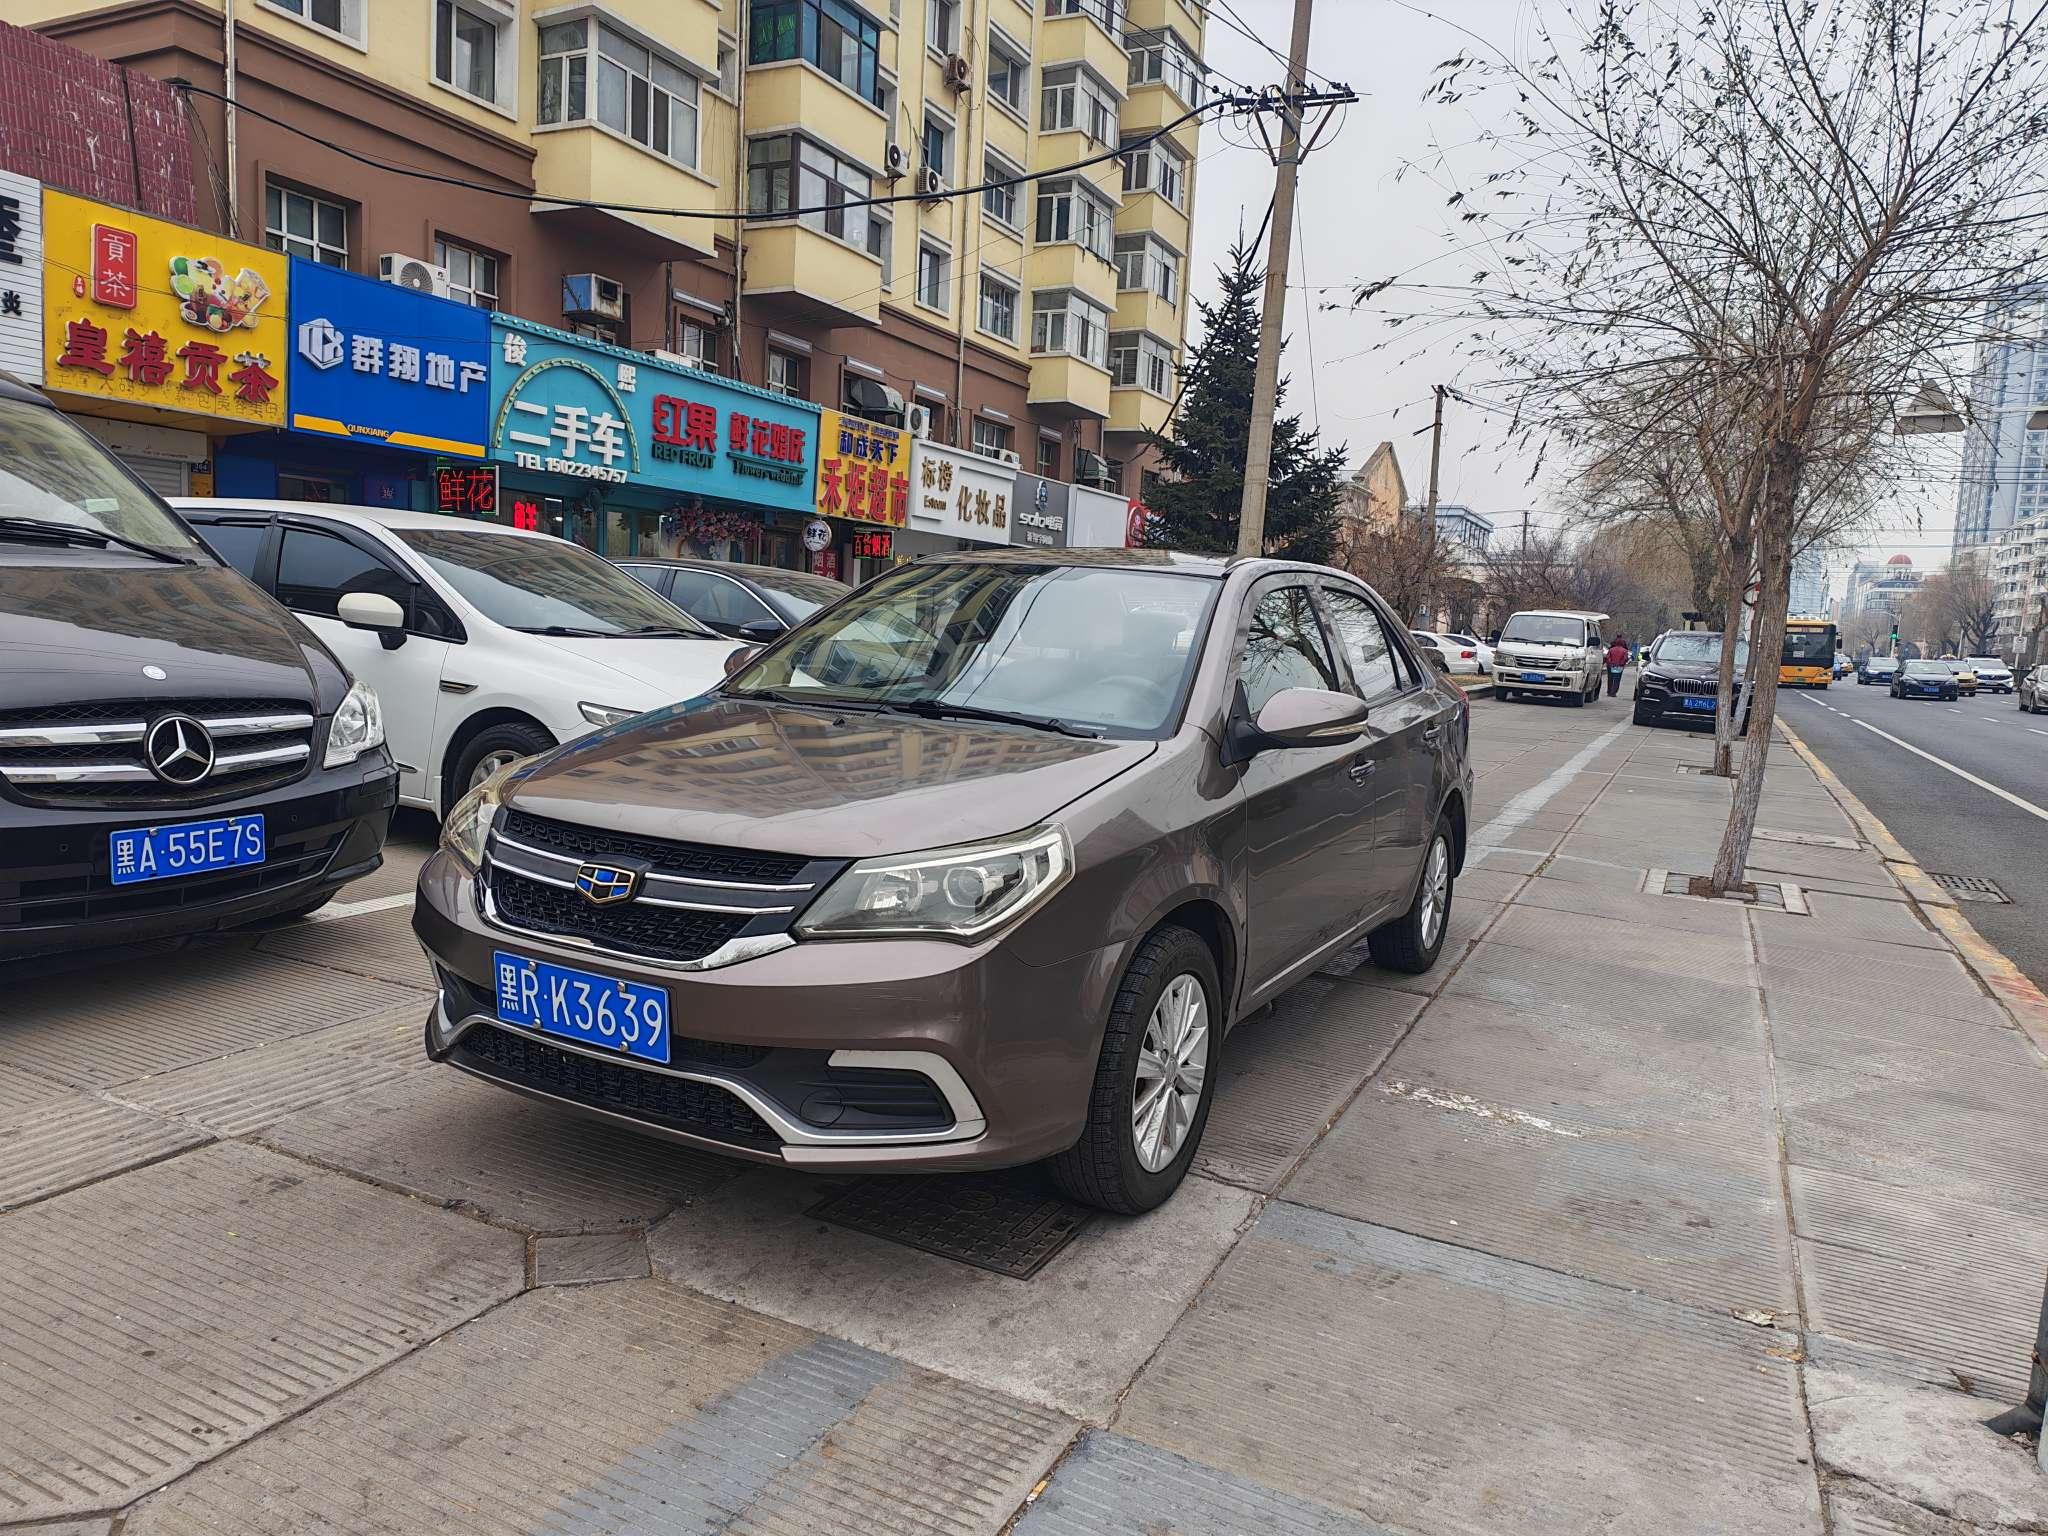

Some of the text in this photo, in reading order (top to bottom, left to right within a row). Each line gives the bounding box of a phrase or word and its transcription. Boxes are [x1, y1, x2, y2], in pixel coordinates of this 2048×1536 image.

[57, 317, 280, 403] 皇禧贡茶
[351, 334, 487, 393] 群翔地产
[347, 423, 390, 438] QUNXIANG
[509, 400, 625, 465] 二手车
[653, 393, 718, 453] 红果
[730, 411, 806, 464] 鲜花婚庆
[515, 451, 545, 471] TEL
[680, 450, 717, 469] FRUIT
[921, 455, 954, 492] 标榜
[439, 469, 495, 513] 鲜花
[956, 485, 1007, 529] 化妆品
